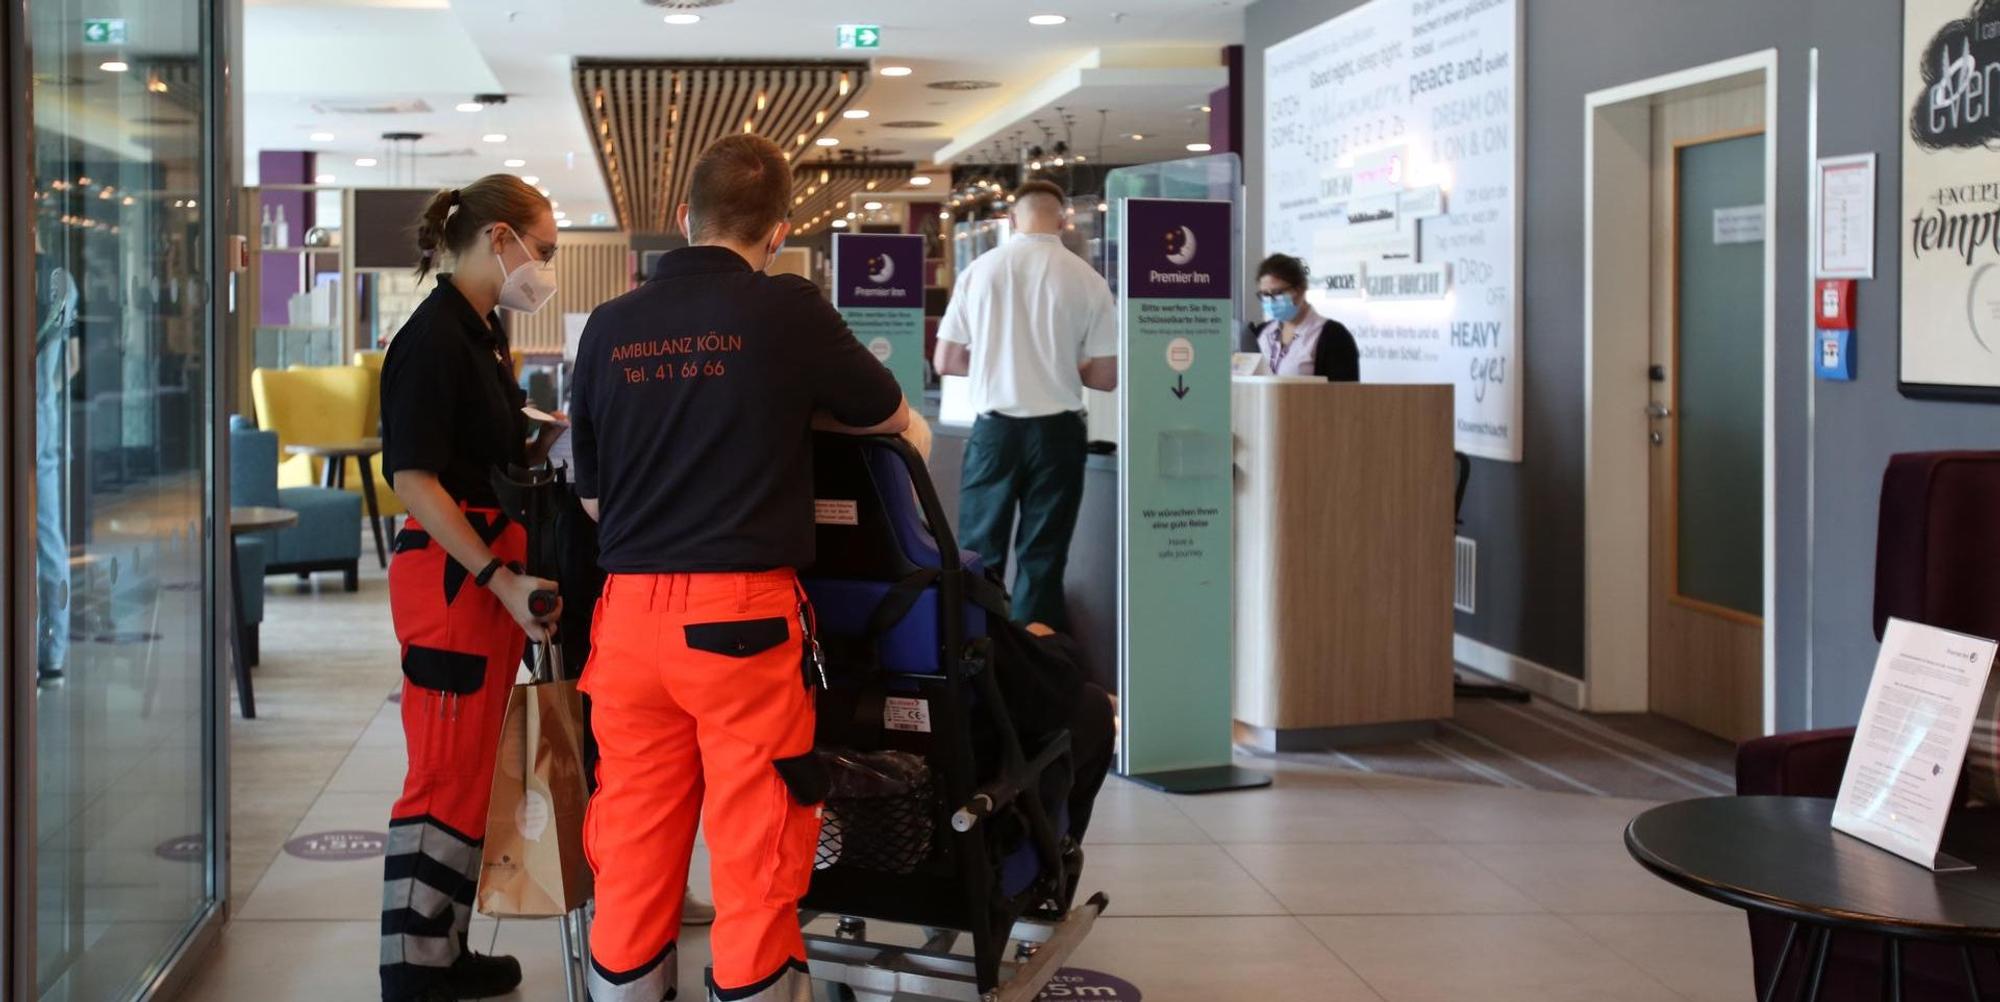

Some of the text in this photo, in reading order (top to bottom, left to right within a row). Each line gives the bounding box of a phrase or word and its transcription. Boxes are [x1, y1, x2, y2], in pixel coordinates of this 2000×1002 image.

[1409, 61, 1454, 104] peace
[1457, 47, 1484, 80] and
[1484, 86, 1509, 117] ON
[1444, 134, 1467, 161] ON
[1484, 125, 1508, 153] ON
[1937, 181, 2000, 207] EXCEPT
[1150, 270, 1210, 284] Premier Inn
[1458, 256, 1495, 285] DROP
[854, 286, 906, 297] Premier Inn
[611, 331, 742, 361] AMBULANZ KÖLN
[1450, 321, 1501, 348] HEAVY
[624, 360, 725, 384] Tel. 41 66 66
[1469, 356, 1506, 404] eyes
[1152, 521, 1169, 530] eine
[1170, 520, 1187, 531] gute
[1040, 983, 1117, 998] ,5m
